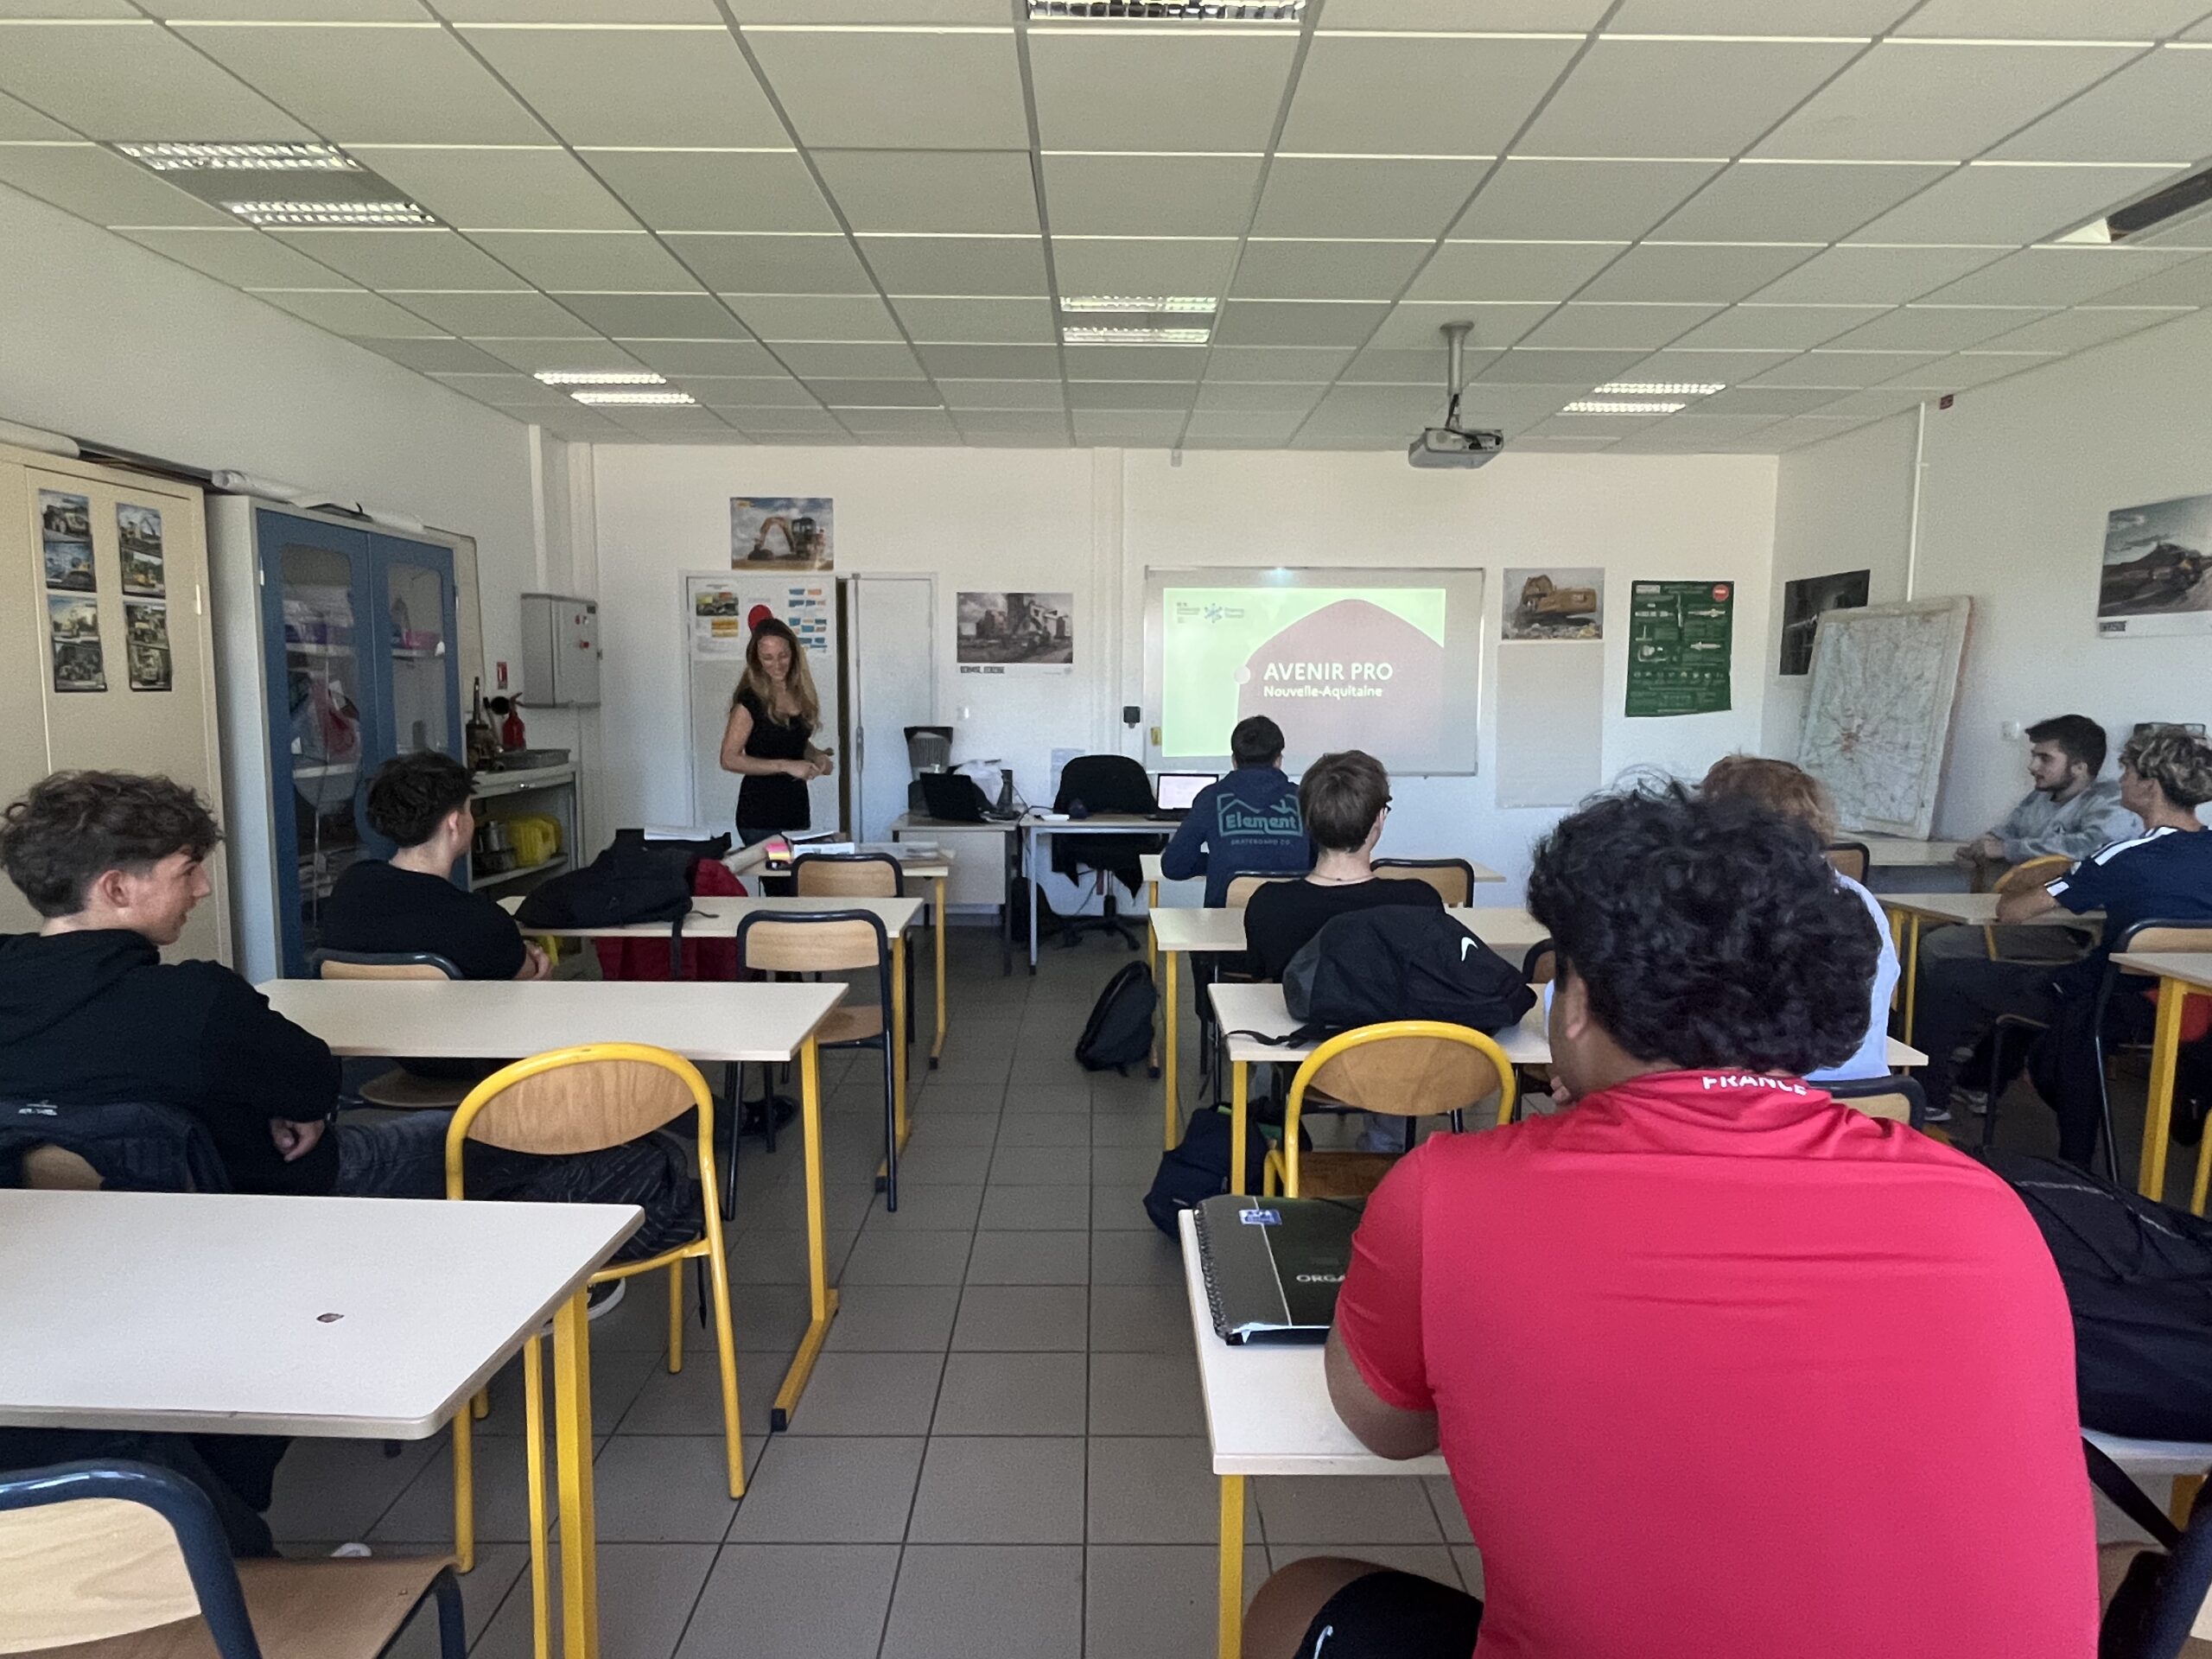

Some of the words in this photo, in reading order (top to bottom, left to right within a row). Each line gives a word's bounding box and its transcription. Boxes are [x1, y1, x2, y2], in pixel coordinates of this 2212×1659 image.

[1263, 663, 1344, 681] AVENIR
[1351, 663, 1394, 681] PRO
[1263, 685, 1383, 701] Nouvelle-Aquitaine
[1225, 811, 1297, 830] Element
